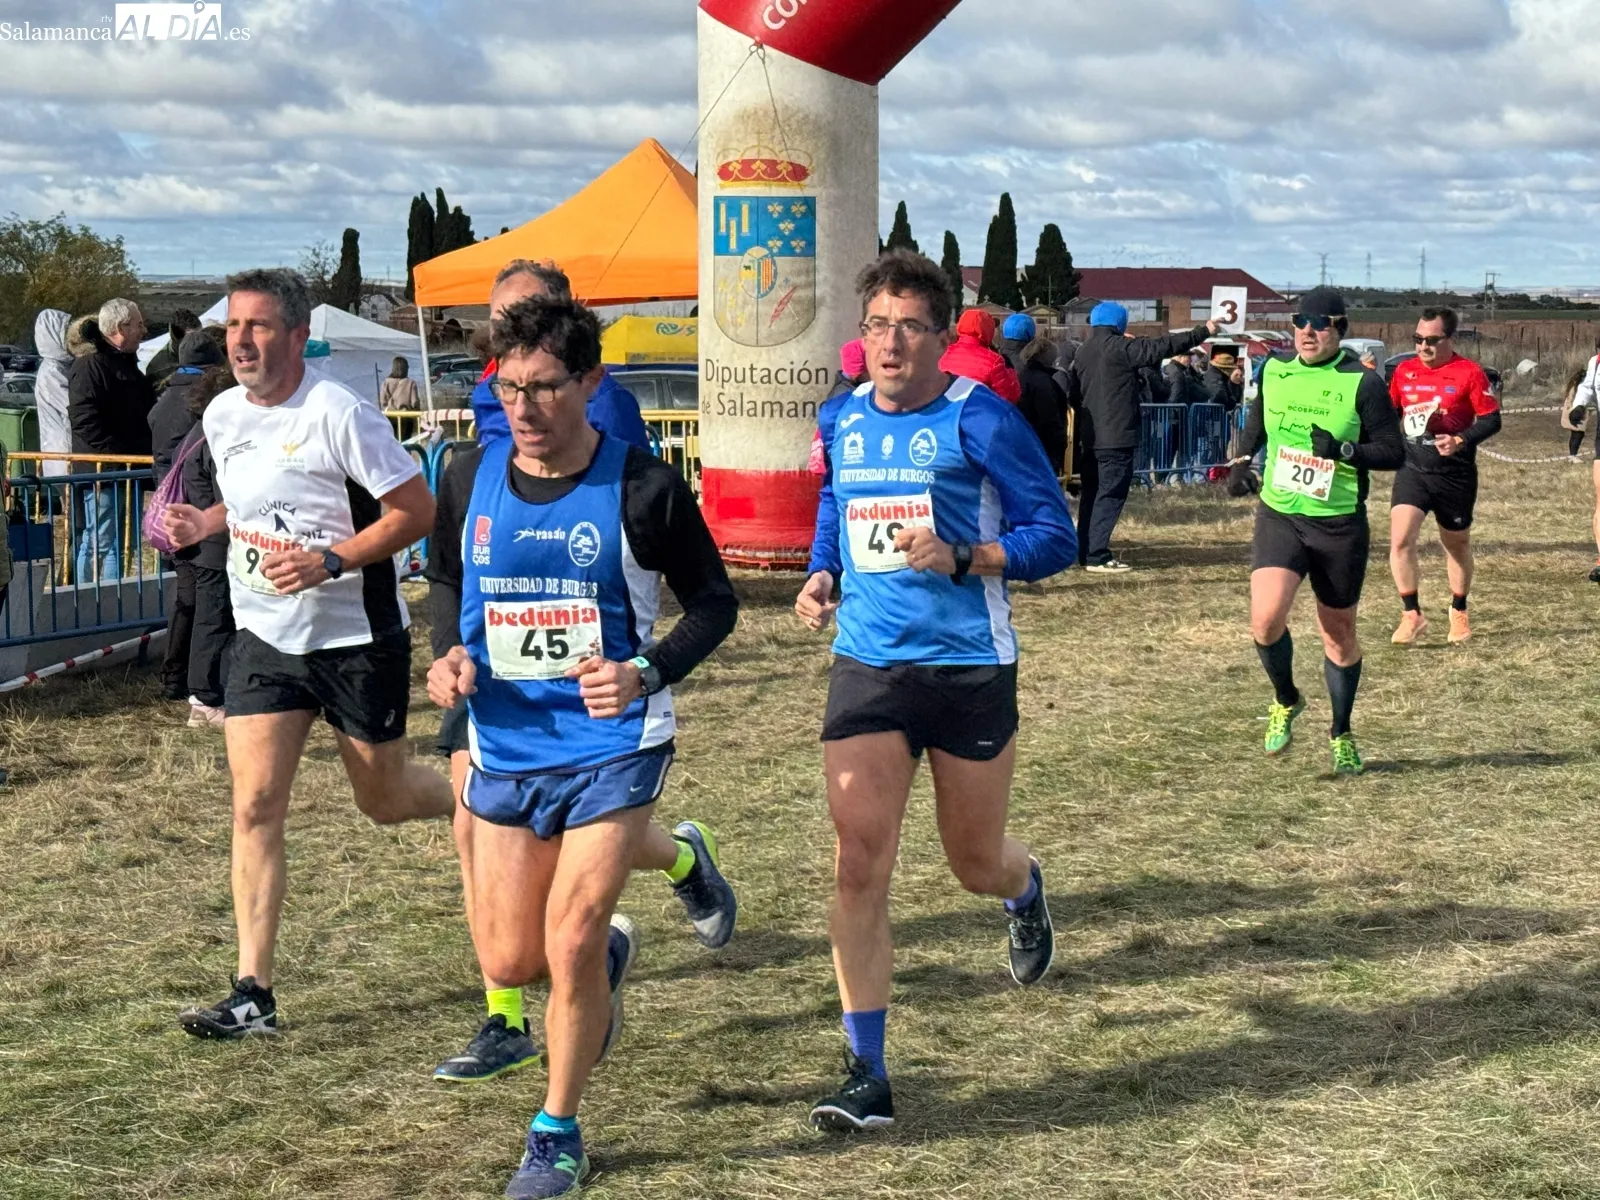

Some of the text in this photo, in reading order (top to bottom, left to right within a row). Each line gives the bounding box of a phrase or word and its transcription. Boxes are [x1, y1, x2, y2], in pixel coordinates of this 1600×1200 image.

[762, 0, 807, 30] CO
[1218, 300, 1238, 325] 3
[705, 358, 829, 390] Diputación
[701, 392, 825, 418] de Salaman
[840, 468, 936, 484] UNIVERSIDAD DE BURGOS
[1291, 464, 1315, 486] 20
[849, 501, 930, 521] bedunia
[479, 576, 598, 597] UNIVERSIDAD DE BURGOS
[488, 604, 598, 627] bedunia
[520, 628, 570, 661] 45
